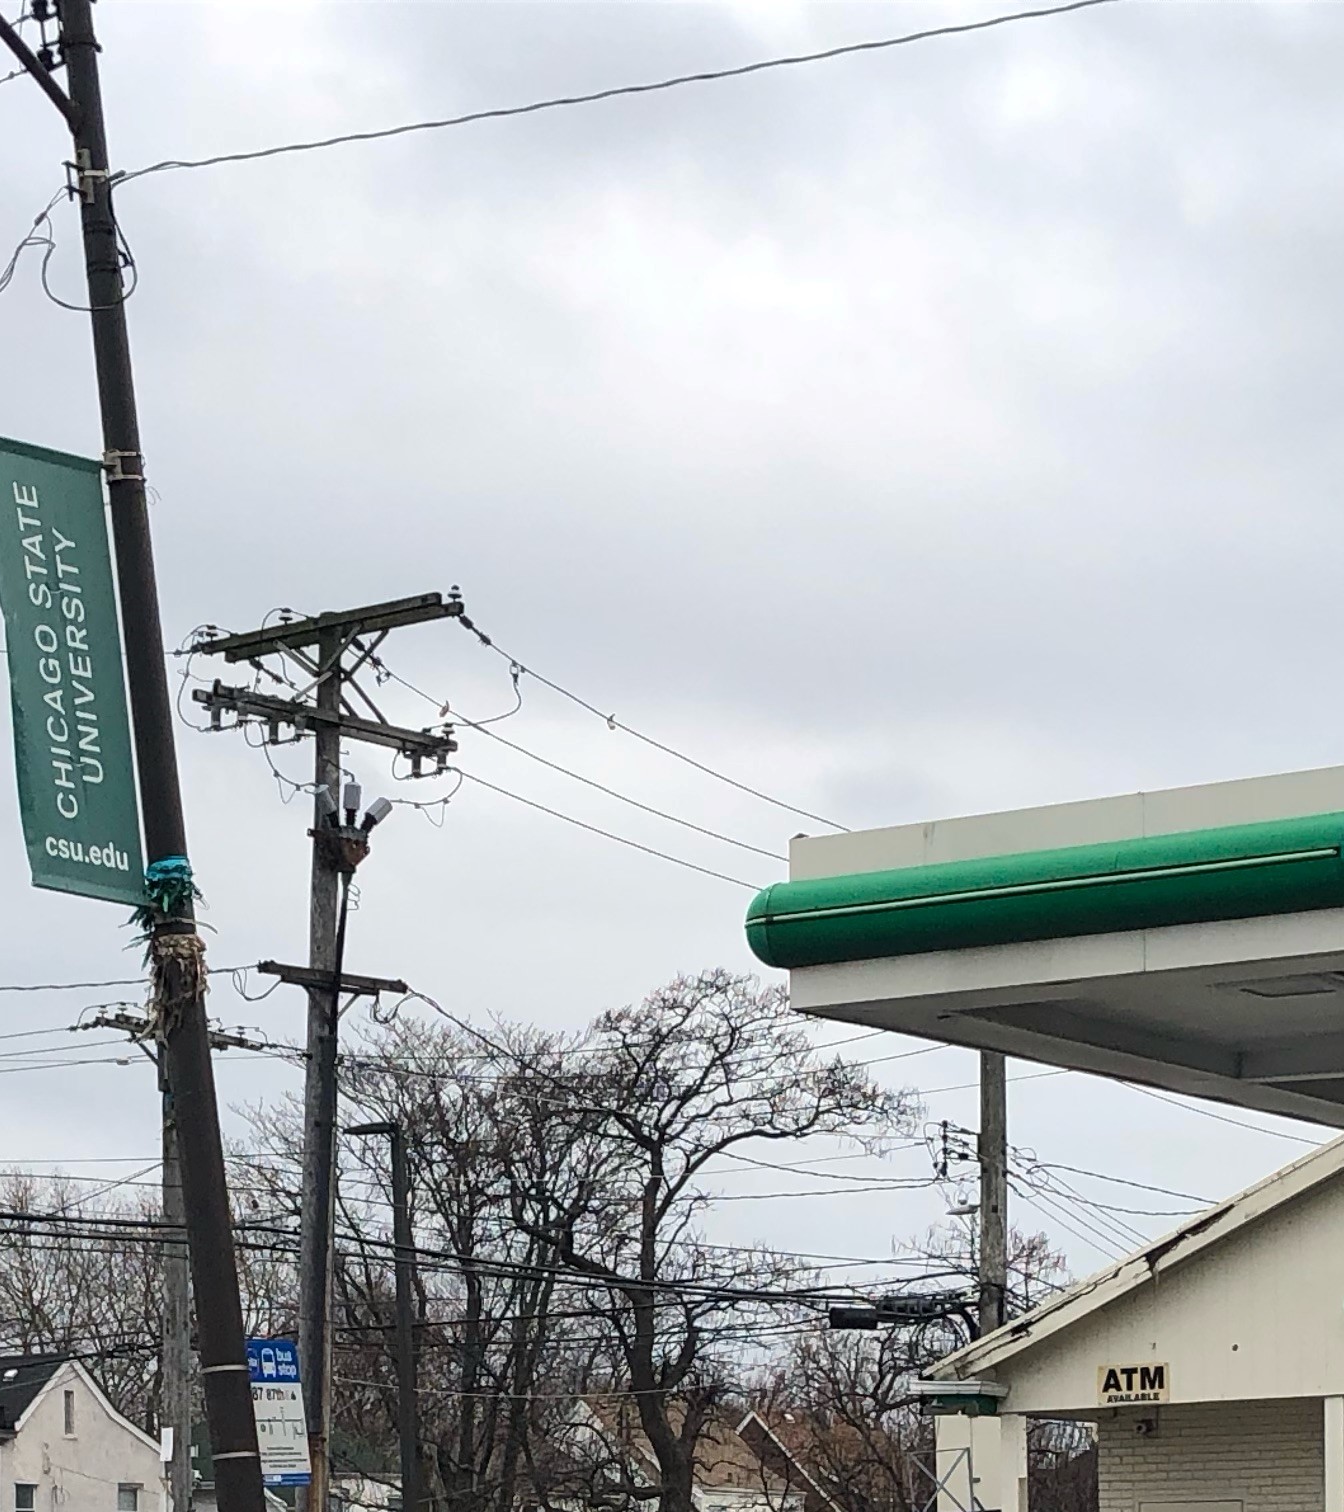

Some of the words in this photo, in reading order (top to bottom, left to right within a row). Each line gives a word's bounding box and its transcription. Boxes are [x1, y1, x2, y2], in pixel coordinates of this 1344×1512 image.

[11, 480, 53, 610] STATE
[50, 526, 105, 785] UNIVERSITY
[34, 622, 80, 820] CHICAGO
[45, 834, 130, 873] csu.edu
[1101, 1365, 1165, 1394] ATM
[1106, 1392, 1160, 1404] AVAILABLE
